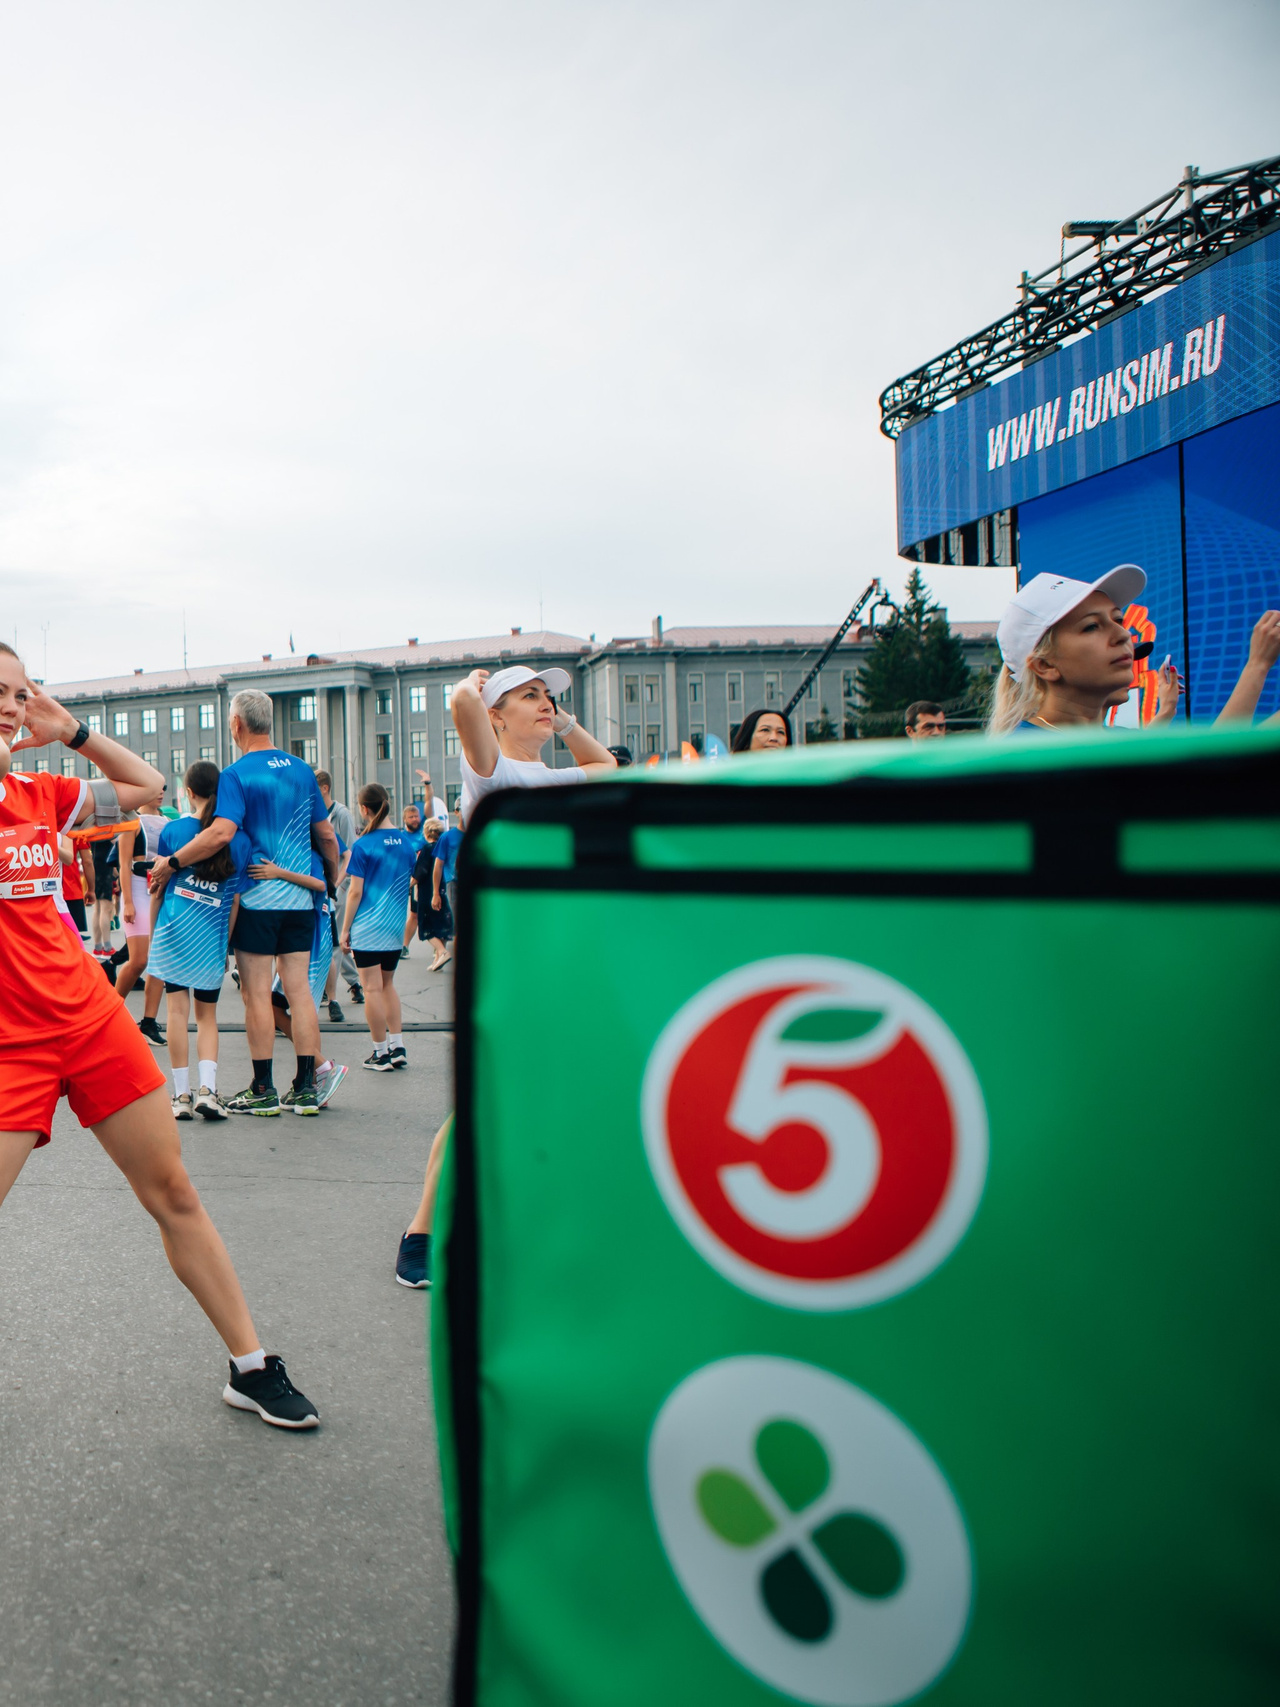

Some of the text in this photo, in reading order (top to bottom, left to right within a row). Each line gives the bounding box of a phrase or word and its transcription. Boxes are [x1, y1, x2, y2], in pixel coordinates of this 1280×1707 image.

[986, 314, 1226, 473] WWW.RUNSIM.RU
[5, 843, 54, 869] 2080
[185, 874, 219, 892] 4106
[716, 984, 907, 1243] 5
